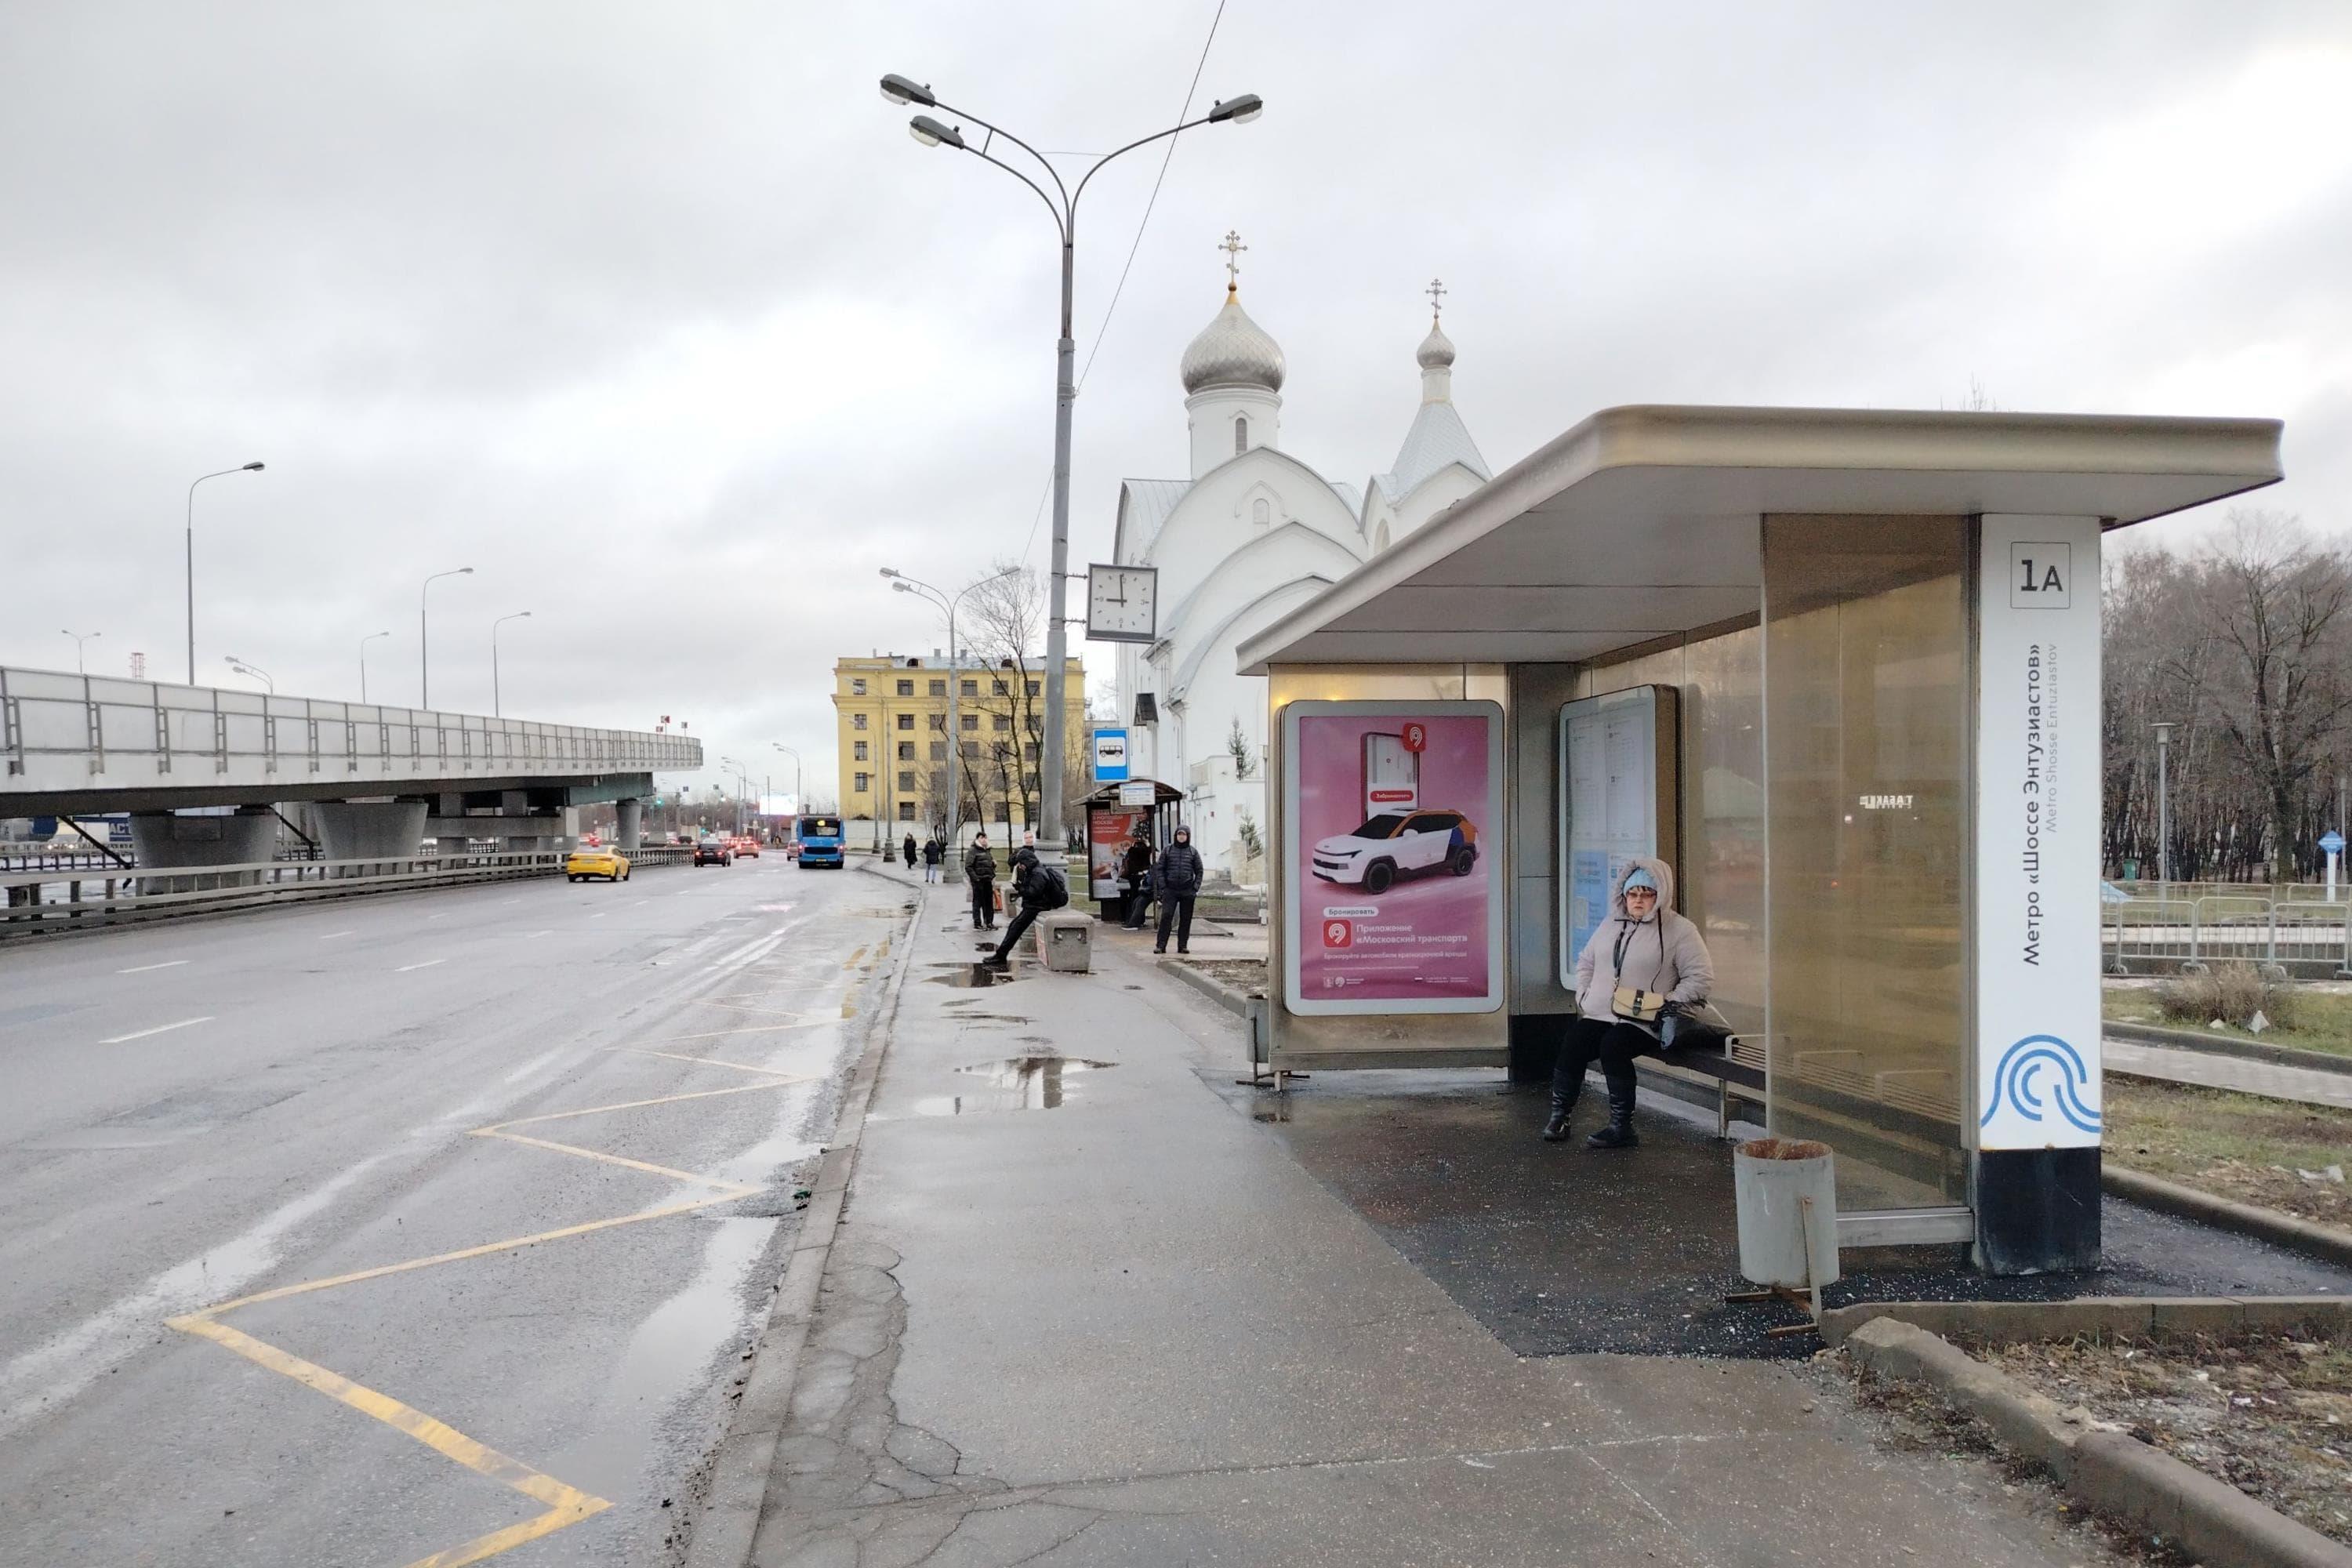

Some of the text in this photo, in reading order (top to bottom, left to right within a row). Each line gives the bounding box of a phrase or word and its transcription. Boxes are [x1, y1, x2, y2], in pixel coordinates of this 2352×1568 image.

[2020, 559, 2063, 592] 1А
[2045, 644, 2058, 833] Metro Shosse Entuziastov
[2023, 644, 2044, 966] Метро «Шоссе Энтузиастов»
[1328, 908, 1375, 916] Бронировать
[1356, 924, 1413, 934] Приложение
[1356, 935, 1468, 944] «Московский транспорт»
